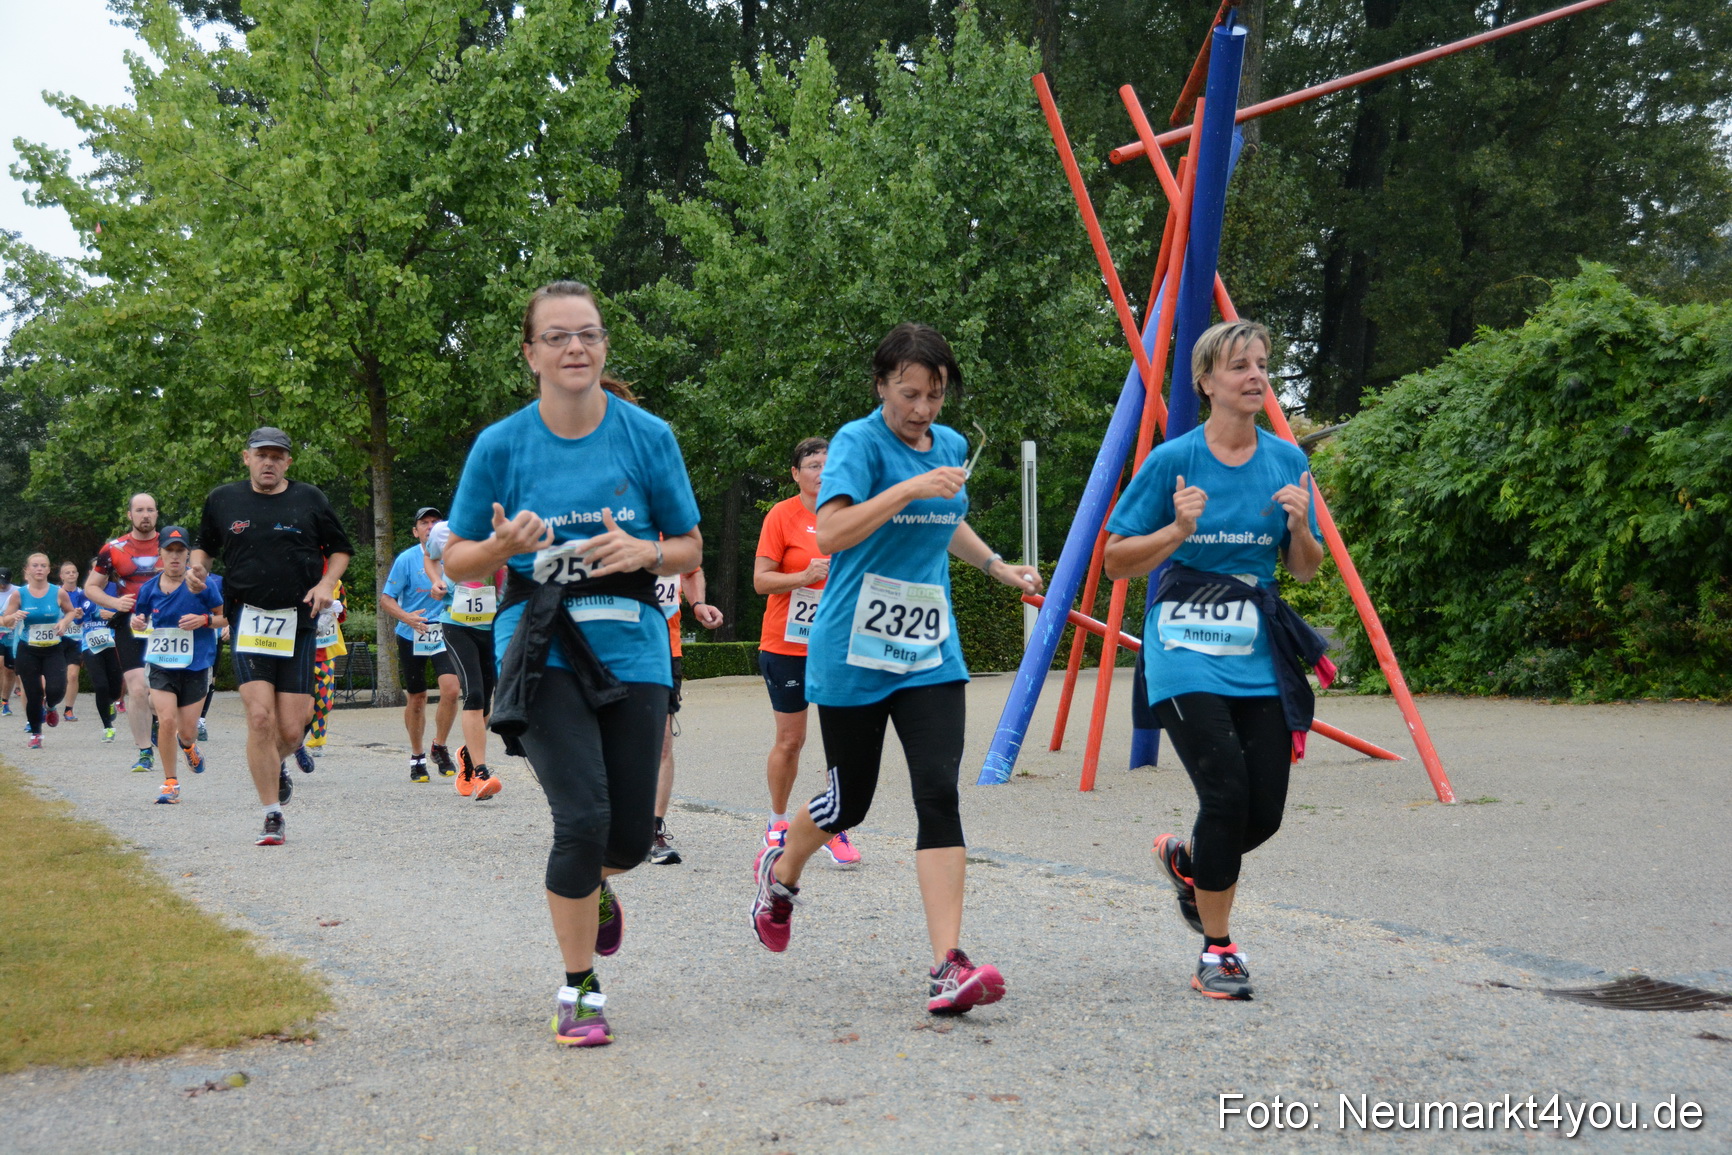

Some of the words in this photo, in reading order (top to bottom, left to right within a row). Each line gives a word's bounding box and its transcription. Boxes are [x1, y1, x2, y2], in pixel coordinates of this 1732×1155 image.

[466, 597, 484, 612] 15
[252, 615, 287, 635] 177
[864, 599, 940, 640] 2329
[35, 630, 54, 640] 256
[89, 634, 110, 647] 3037
[1183, 628, 1232, 643] Antonia
[151, 638, 189, 653] 2316
[254, 638, 278, 648] Stefan
[884, 644, 918, 663] Petra
